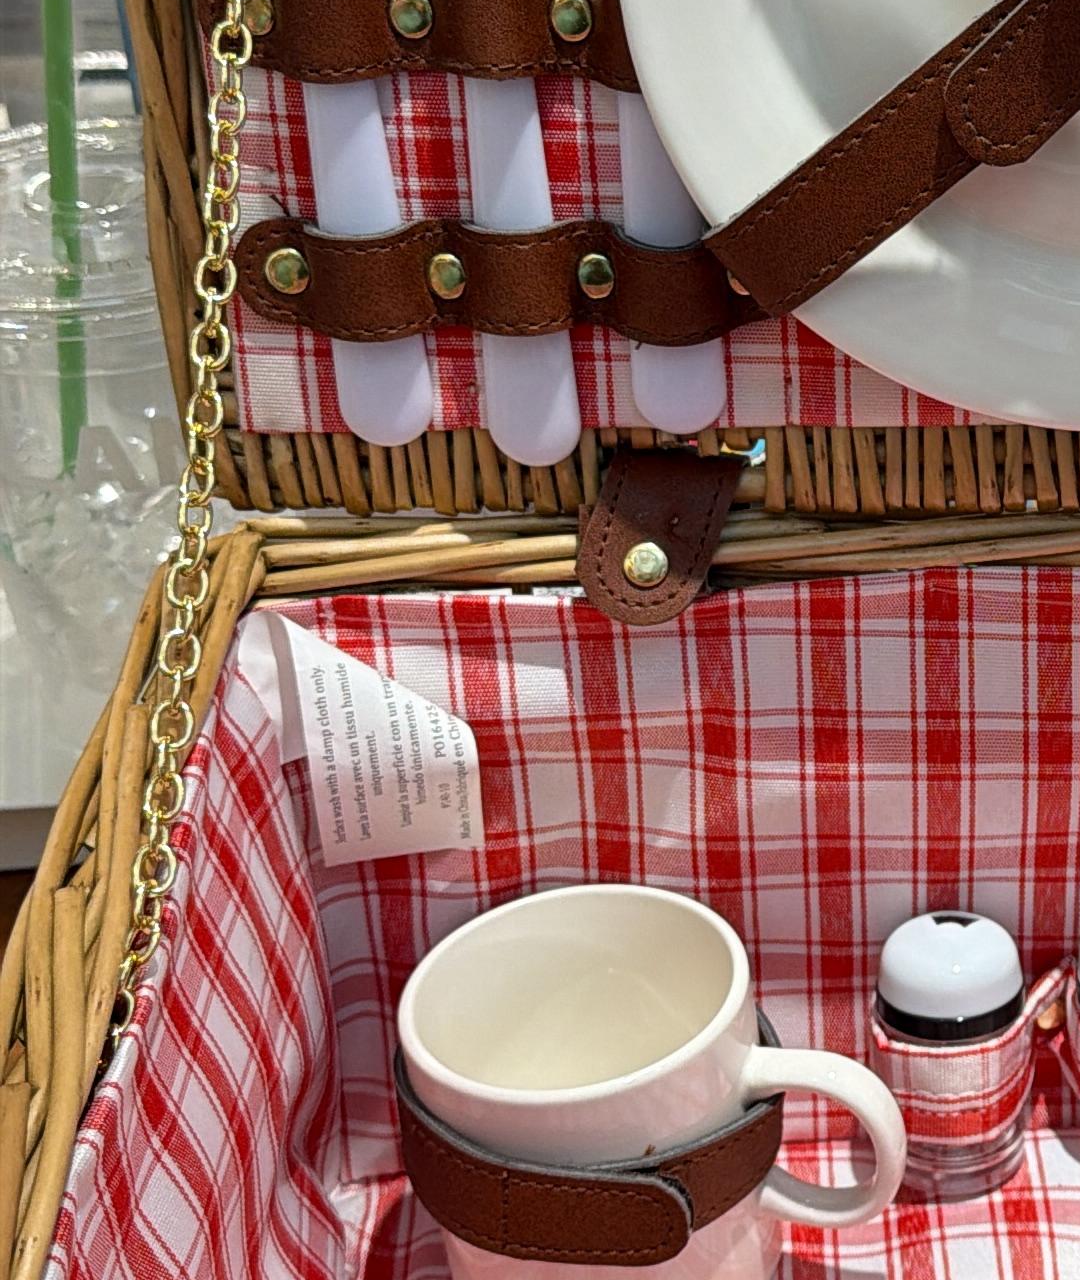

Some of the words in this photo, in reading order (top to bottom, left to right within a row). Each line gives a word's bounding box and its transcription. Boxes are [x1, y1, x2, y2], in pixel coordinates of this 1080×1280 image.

[311, 665, 325, 693] only.
[335, 662, 353, 708] humide
[315, 696, 330, 727] cloth
[387, 701, 397, 718] un
[345, 710, 358, 739] tissu
[390, 720, 401, 741] con
[404, 701, 423, 771] únicamente.
[322, 729, 335, 762] damp
[350, 742, 359, 757] un
[454, 743, 464, 757] en
[352, 759, 363, 783] avec
[365, 730, 384, 796] uniquement.
[392, 744, 411, 793] superficie
[326, 773, 339, 795] with
[329, 796, 343, 818] wash
[354, 784, 367, 813] surface
